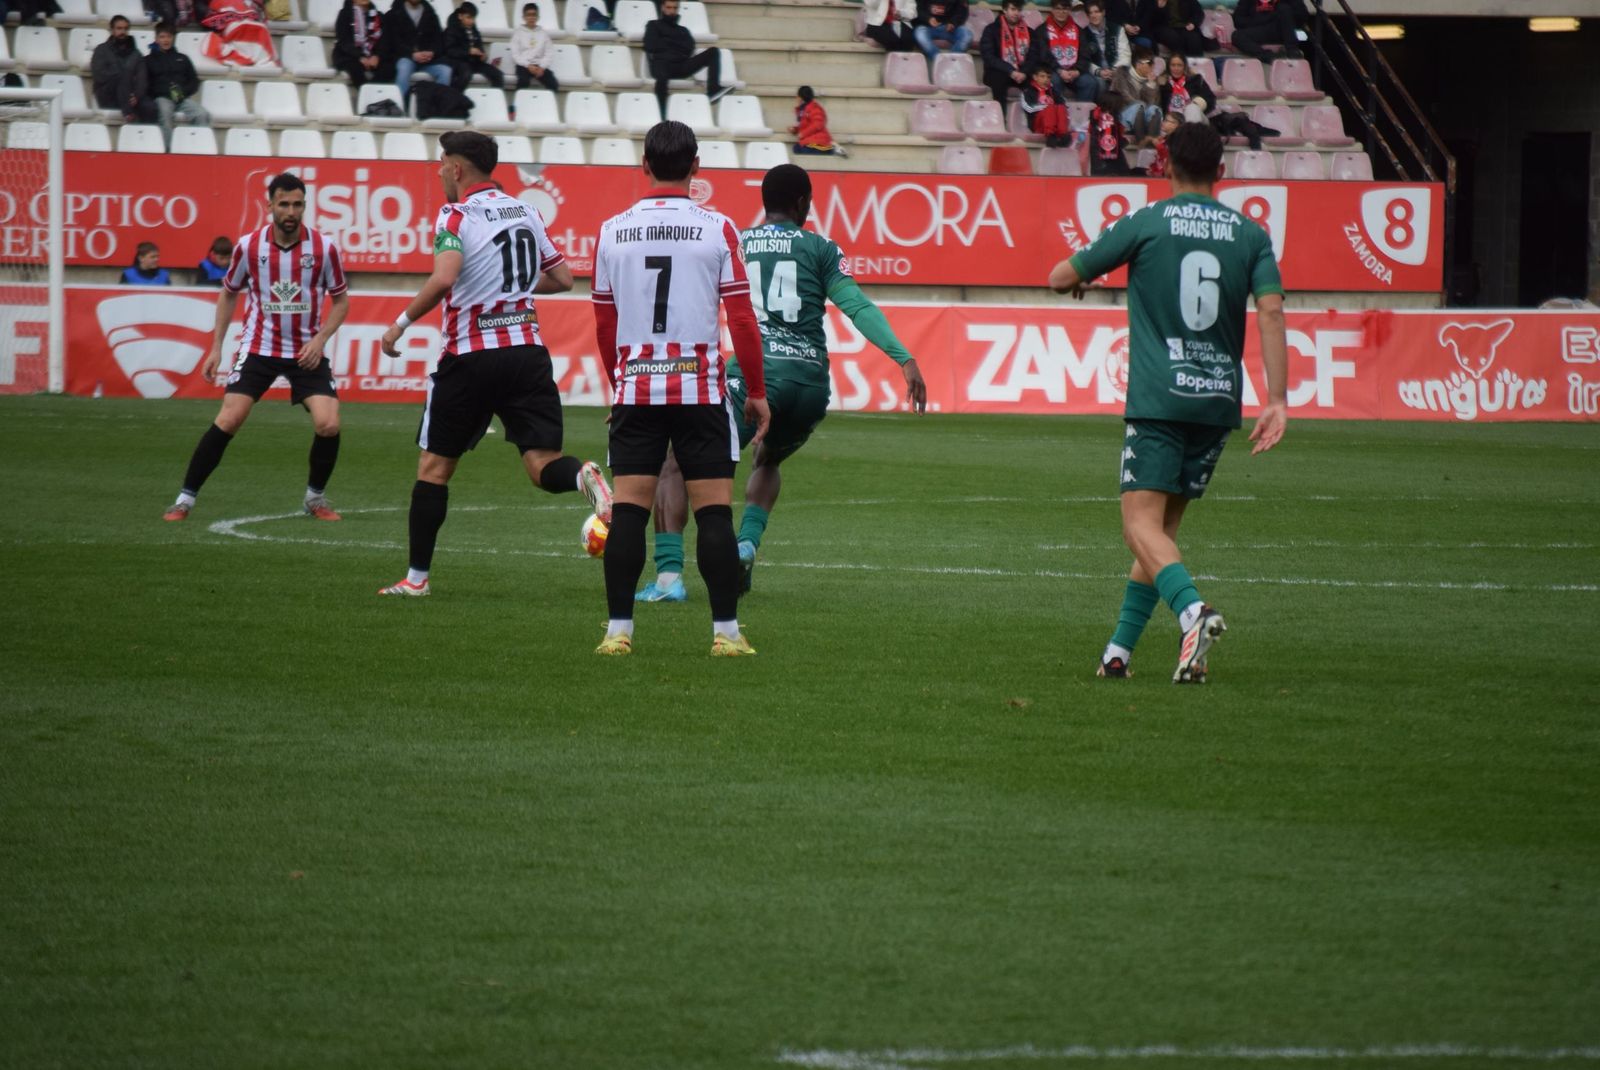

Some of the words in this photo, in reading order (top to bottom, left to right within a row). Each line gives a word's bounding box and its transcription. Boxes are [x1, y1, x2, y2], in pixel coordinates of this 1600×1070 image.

[29, 183, 198, 229] ÓPTICO
[500, 206, 527, 220] RAMOS
[1385, 198, 1414, 250] 8
[646, 221, 703, 241] MÁRQUEZ
[746, 239, 792, 254] ADILSON
[1171, 218, 1209, 240] BRAIS
[1212, 223, 1235, 242] VAL
[492, 229, 537, 293] 10
[1344, 222, 1392, 285] ZAMORA
[645, 256, 672, 333] 7
[747, 260, 802, 323] 14
[1179, 250, 1221, 332] 6
[625, 360, 698, 376] leomotor.net
[1176, 372, 1233, 392] Bopeixe
